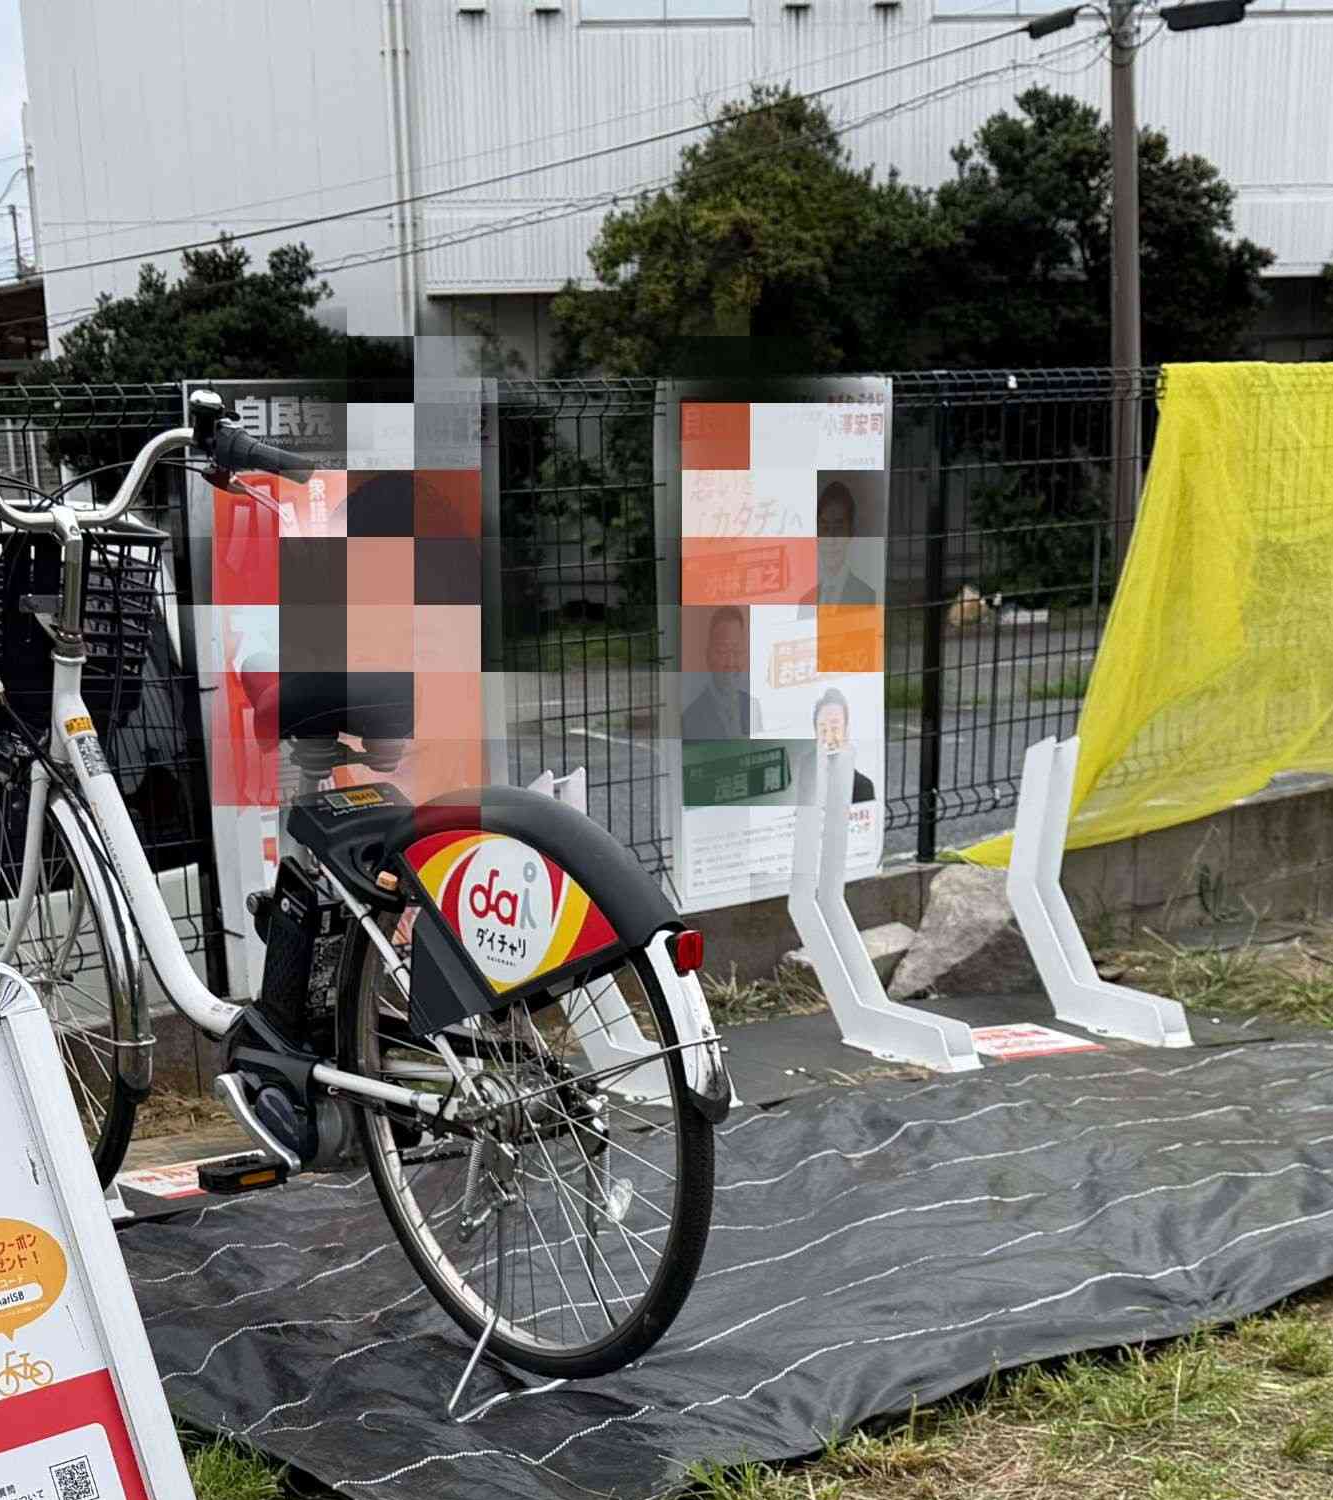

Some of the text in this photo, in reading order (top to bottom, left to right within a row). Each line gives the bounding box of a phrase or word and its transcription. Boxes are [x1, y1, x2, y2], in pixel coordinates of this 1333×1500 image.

[476, 927, 527, 959] ダイチャリ
